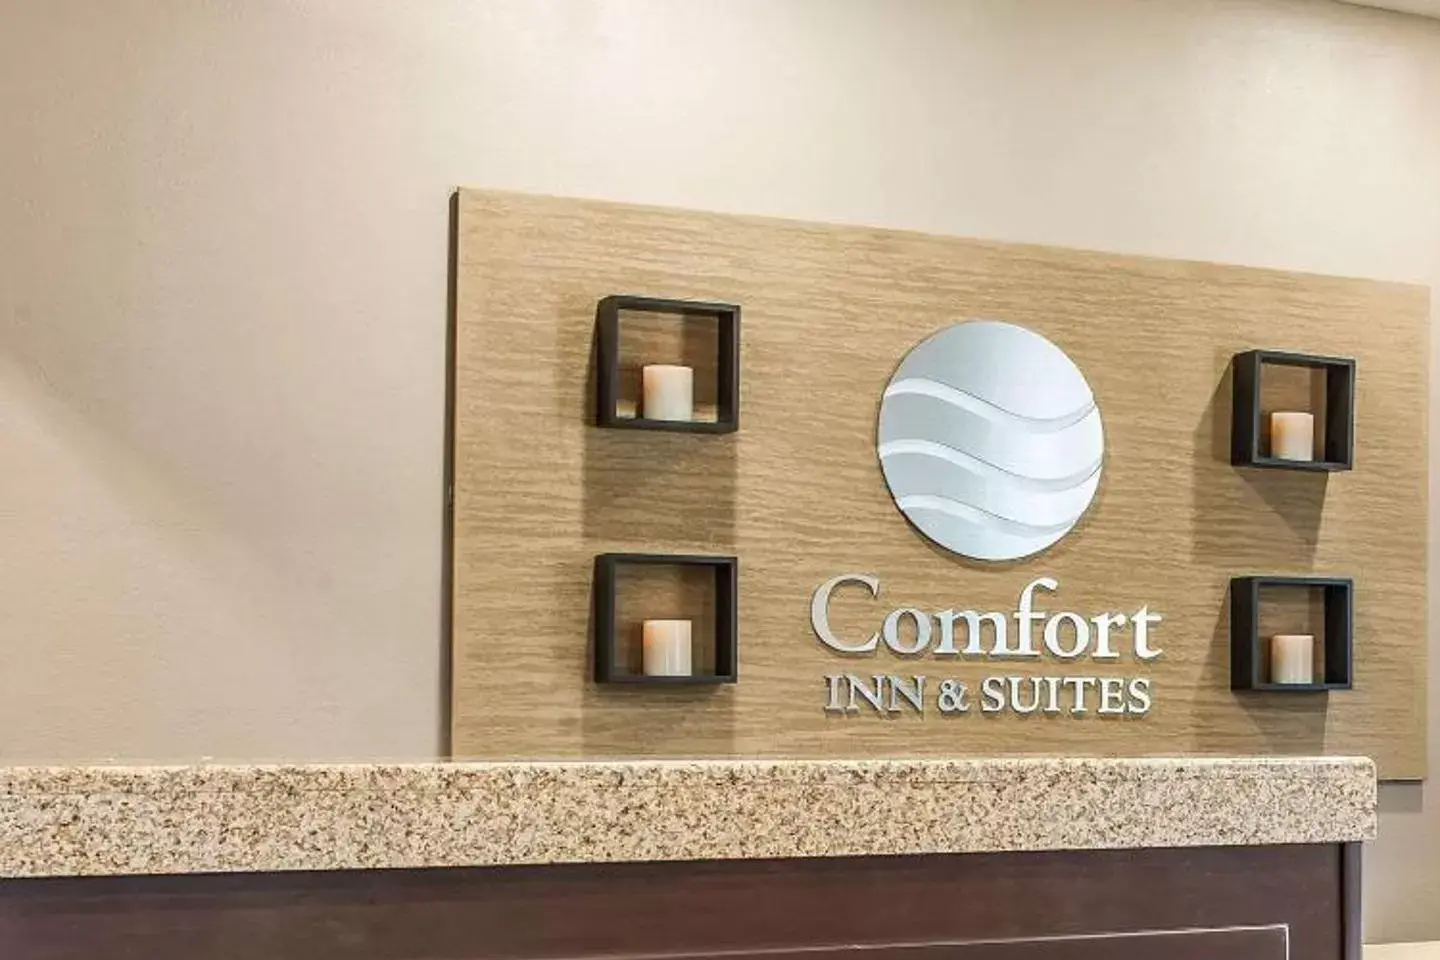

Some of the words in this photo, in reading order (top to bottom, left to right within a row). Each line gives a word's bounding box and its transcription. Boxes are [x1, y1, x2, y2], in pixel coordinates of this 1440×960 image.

[810, 573, 1164, 660] Comfort
[825, 674, 925, 715] INN
[939, 678, 971, 714] &
[980, 676, 1152, 715] SUITES
